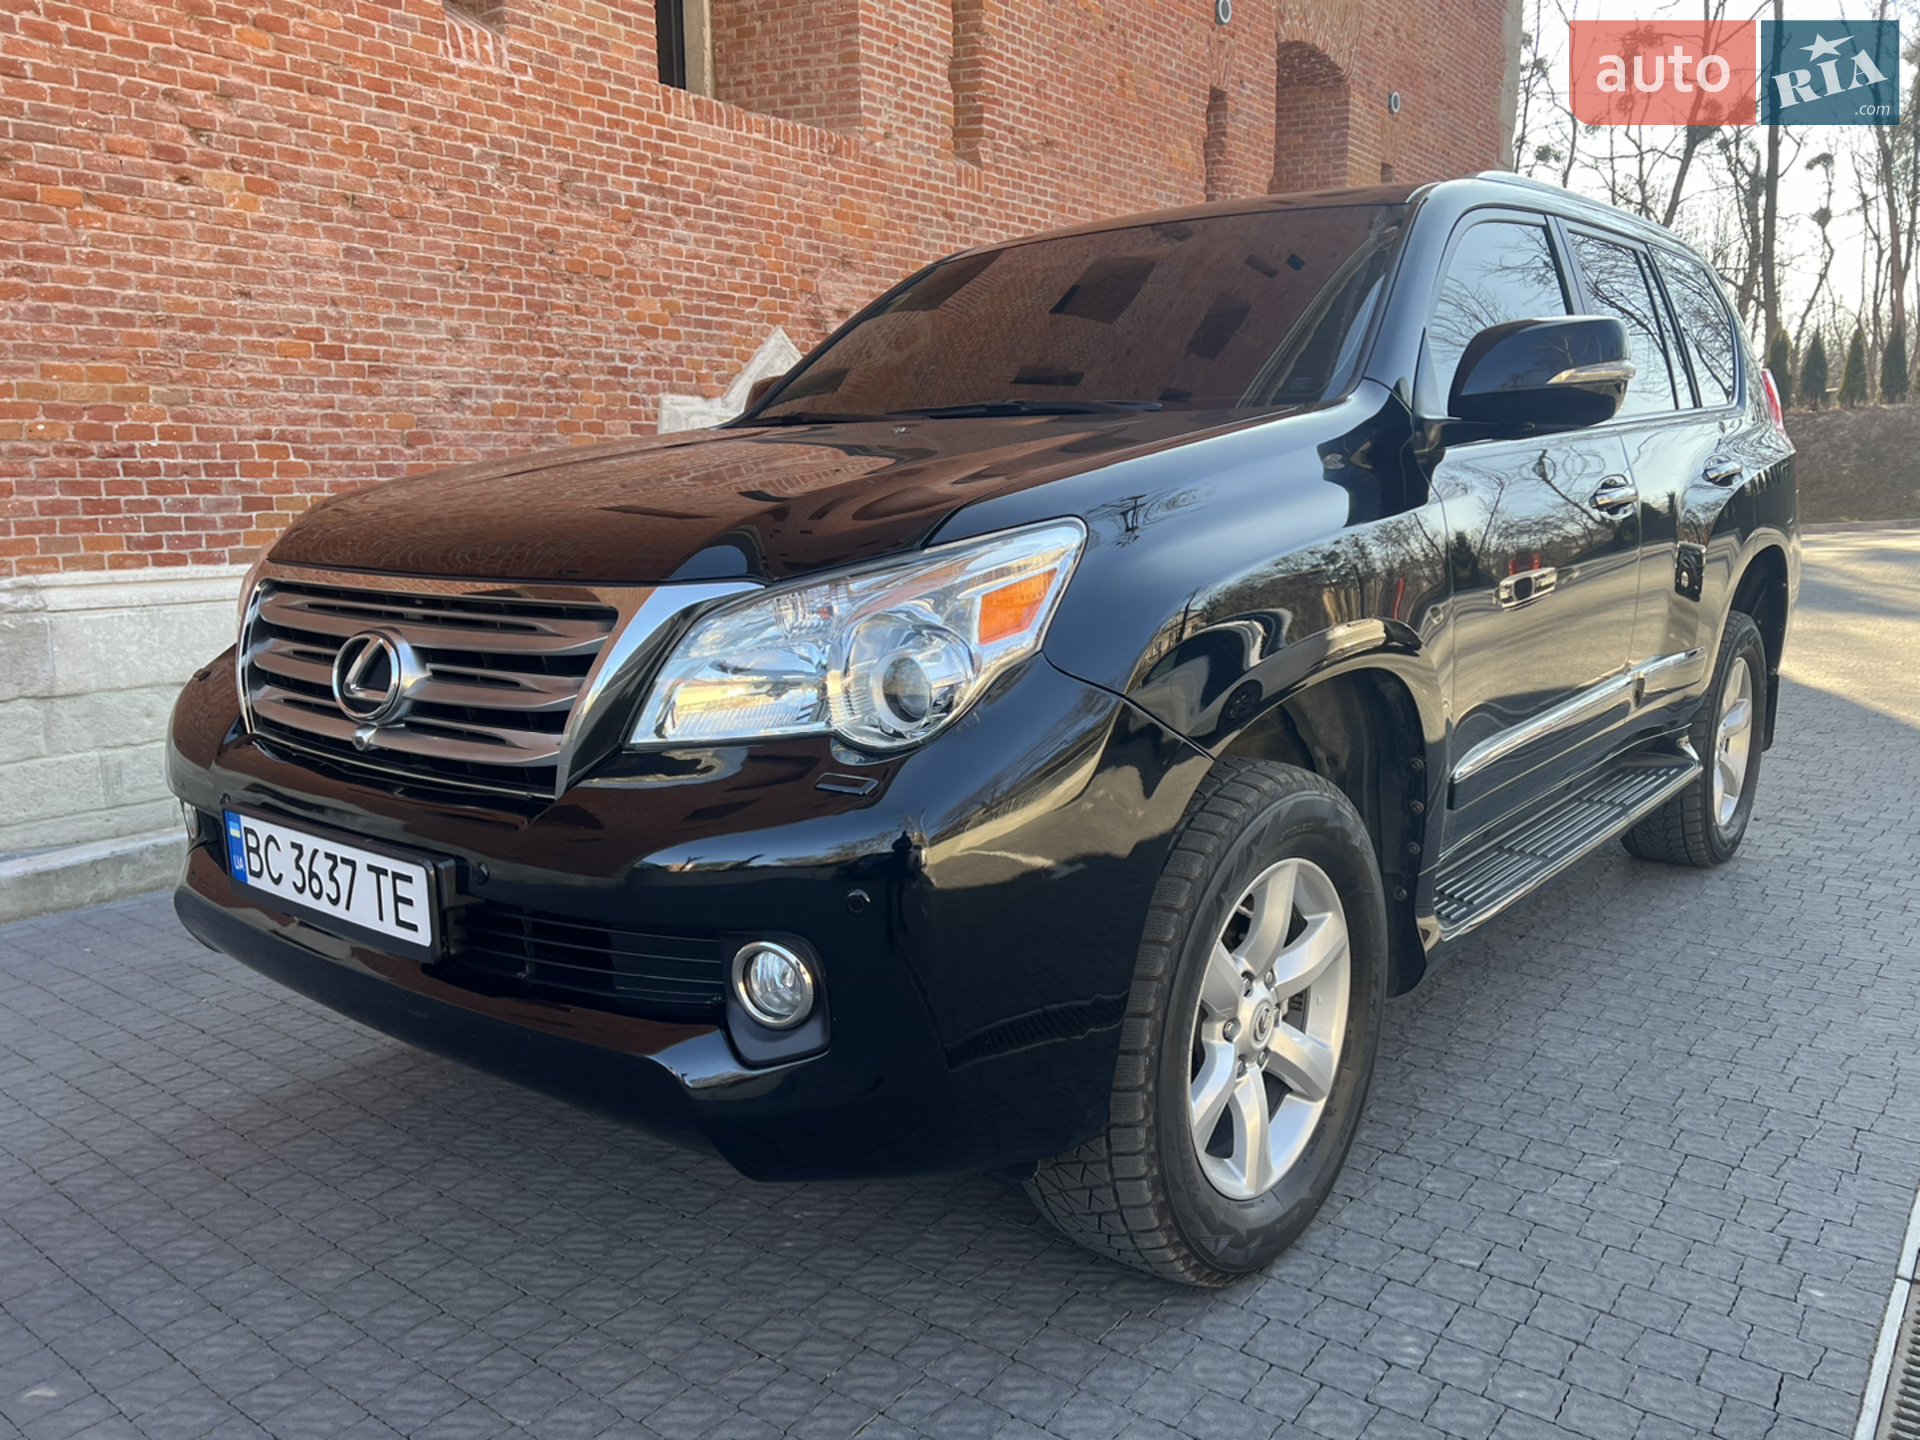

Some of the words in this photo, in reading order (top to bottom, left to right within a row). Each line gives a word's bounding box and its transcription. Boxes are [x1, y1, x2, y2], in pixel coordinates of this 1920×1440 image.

[232, 854, 246, 872] UA
[243, 826, 284, 886] BC
[290, 841, 358, 912] 3637
[366, 863, 419, 933] TE
